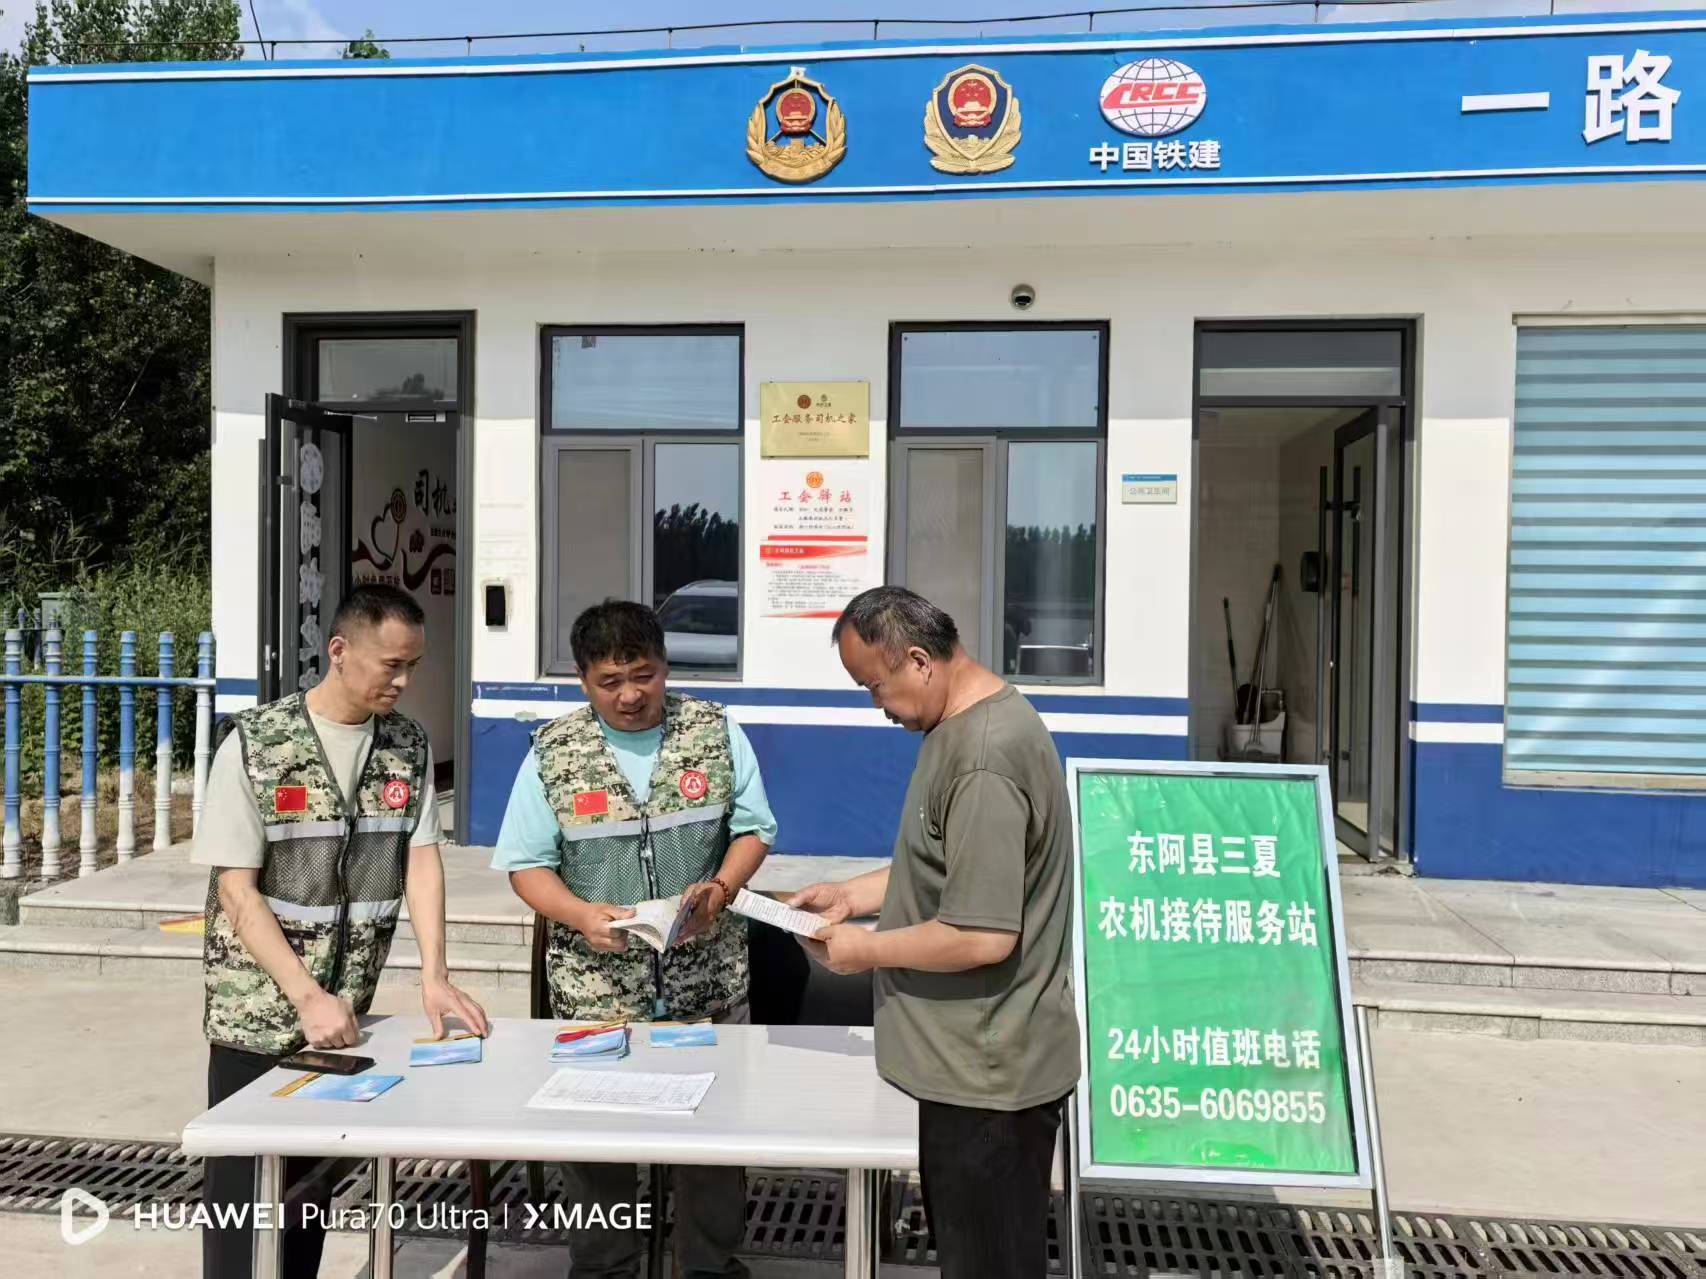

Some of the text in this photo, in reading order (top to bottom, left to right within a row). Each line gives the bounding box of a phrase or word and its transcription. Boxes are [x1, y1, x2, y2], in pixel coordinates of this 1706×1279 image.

[1103, 82, 1202, 109] CRCC
[1461, 49, 1682, 143] 一路
[1089, 141, 1221, 171] 中国铁建
[771, 413, 857, 424] 工会服务司机之家
[1127, 830, 1281, 878] 东阿县三夏
[1098, 895, 1318, 946] 农机接待服务站
[1107, 1025, 1321, 1069] 24小时值班电话
[1110, 1084, 1326, 1124] 0635-6069855
